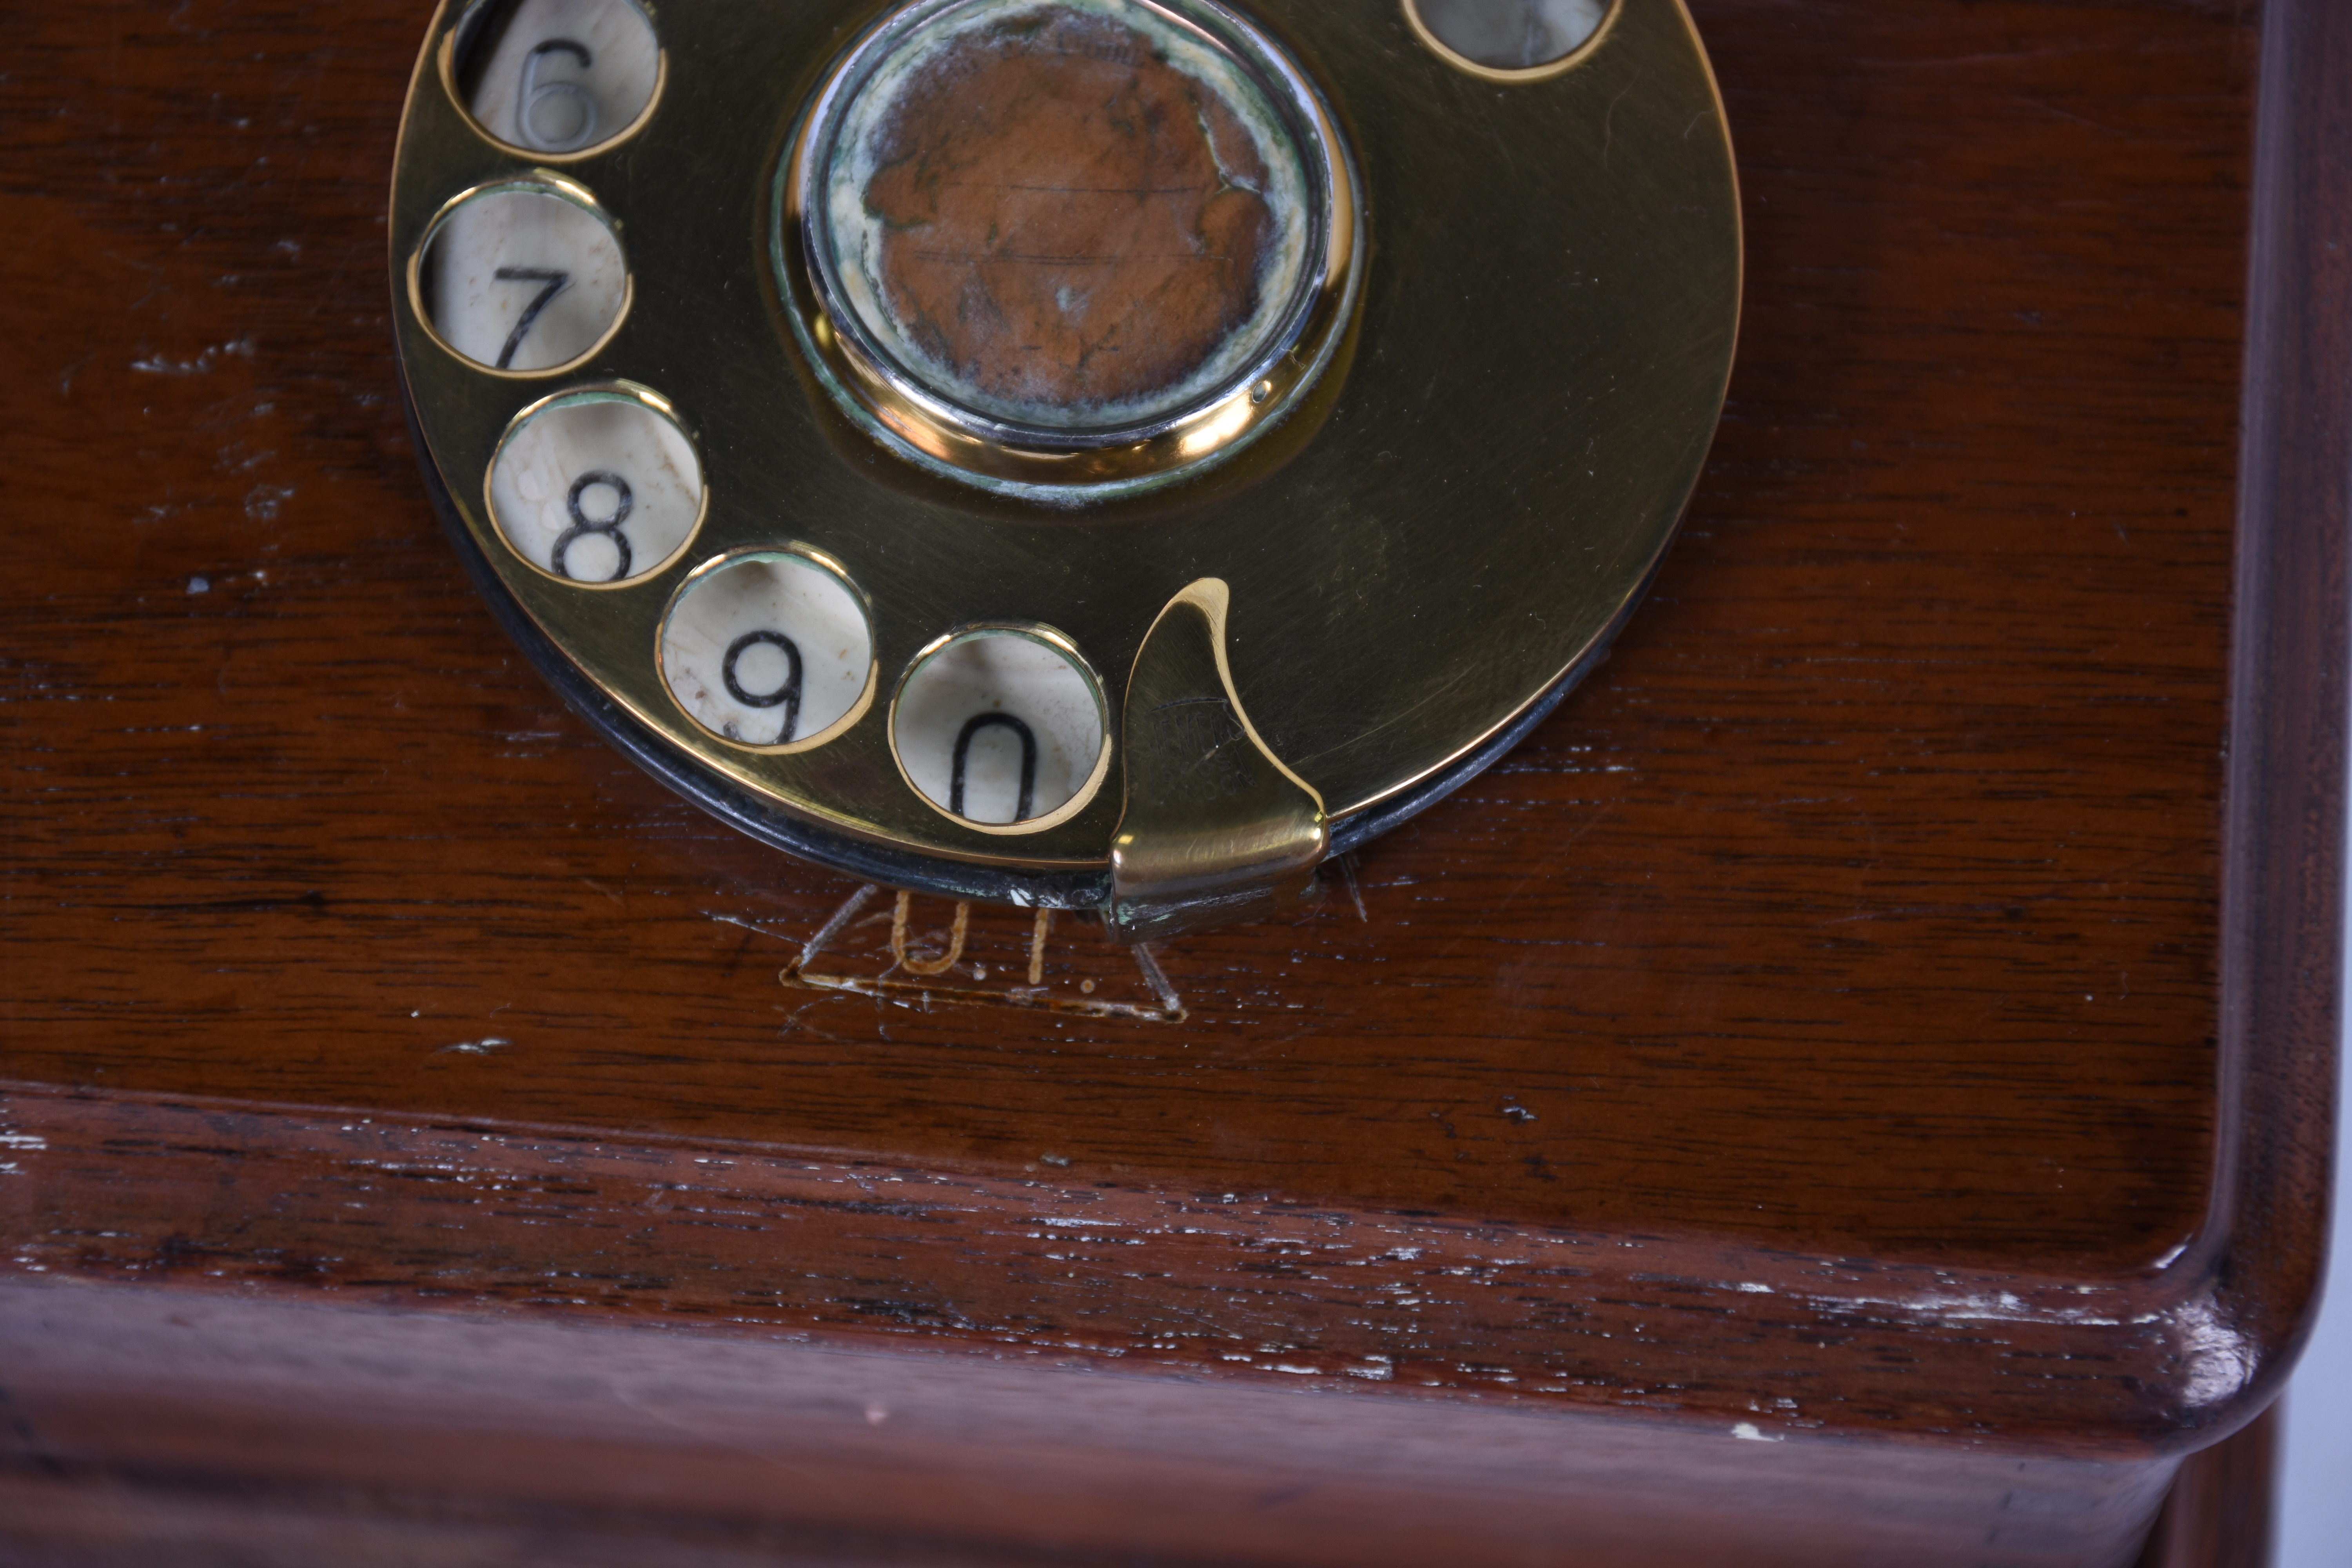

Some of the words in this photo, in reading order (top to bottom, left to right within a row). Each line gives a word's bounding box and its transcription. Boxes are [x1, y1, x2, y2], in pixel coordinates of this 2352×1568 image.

[517, 38, 596, 150] 6
[493, 267, 570, 369] 7
[551, 471, 632, 582] 8
[722, 630, 802, 744] 9
